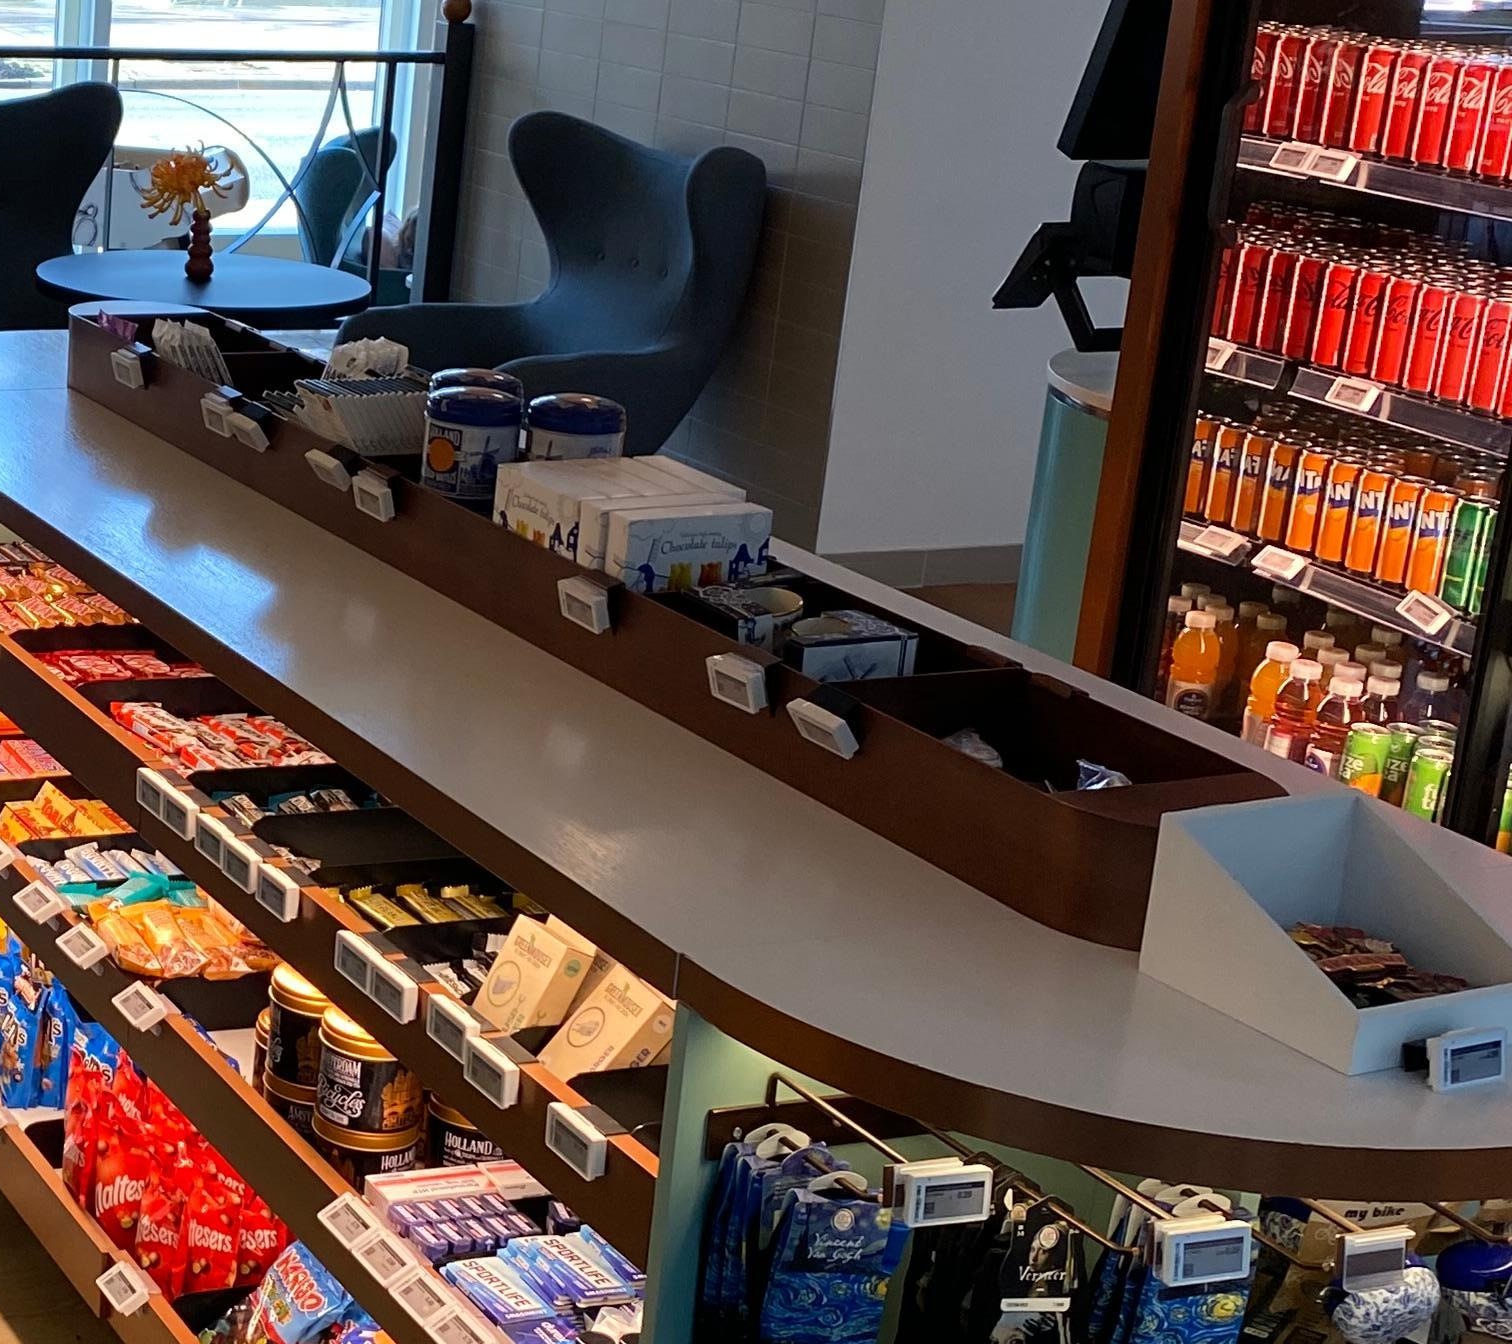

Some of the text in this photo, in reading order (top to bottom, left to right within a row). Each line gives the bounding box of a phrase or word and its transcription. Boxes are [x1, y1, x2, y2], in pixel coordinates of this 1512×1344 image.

[659, 535, 738, 556] Chocolate tulips
[444, 1131, 493, 1156] HOLLAND
[94, 1174, 148, 1219] Maltes
[1344, 1205, 1405, 1221] my bike
[239, 1227, 278, 1249] esers
[543, 1237, 613, 1289] SPORTLIFE
[462, 1259, 531, 1308] SPORTLIFE
